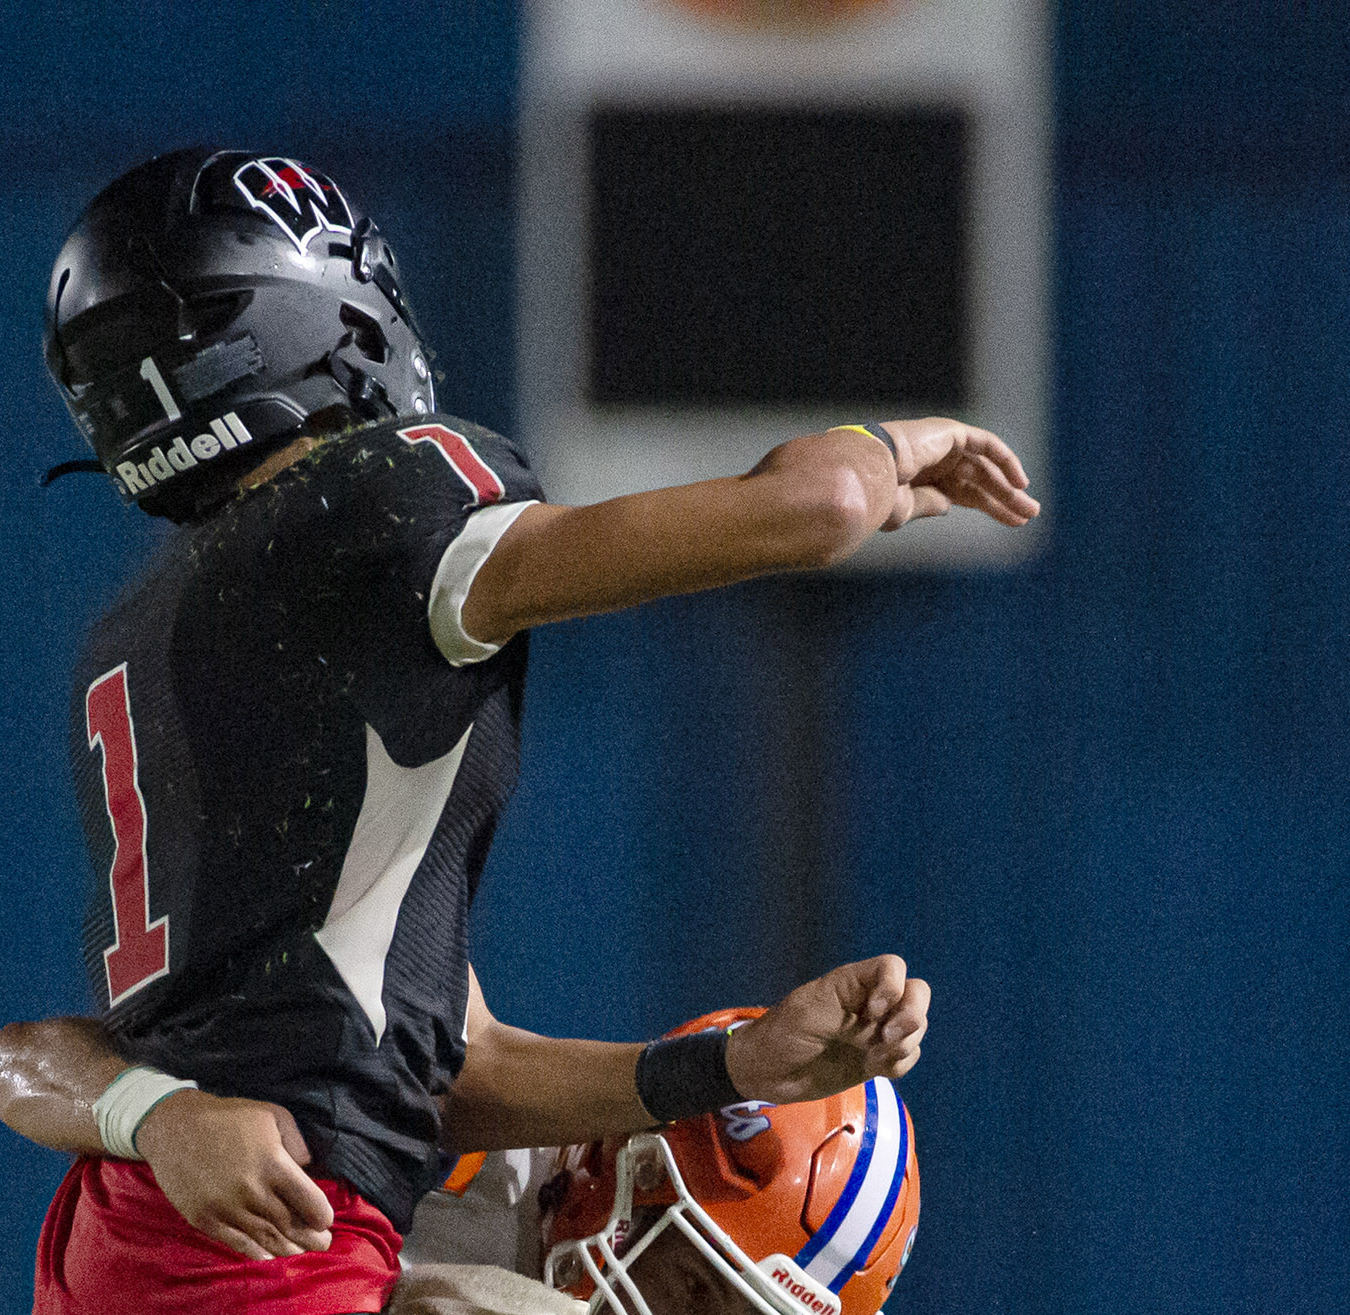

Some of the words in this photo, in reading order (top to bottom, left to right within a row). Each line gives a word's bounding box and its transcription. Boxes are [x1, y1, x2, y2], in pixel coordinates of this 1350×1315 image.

[233, 157, 356, 257] W
[140, 356, 182, 422] 1
[116, 411, 253, 495] Riddell
[397, 422, 506, 512] 1
[86, 661, 169, 1008] 1
